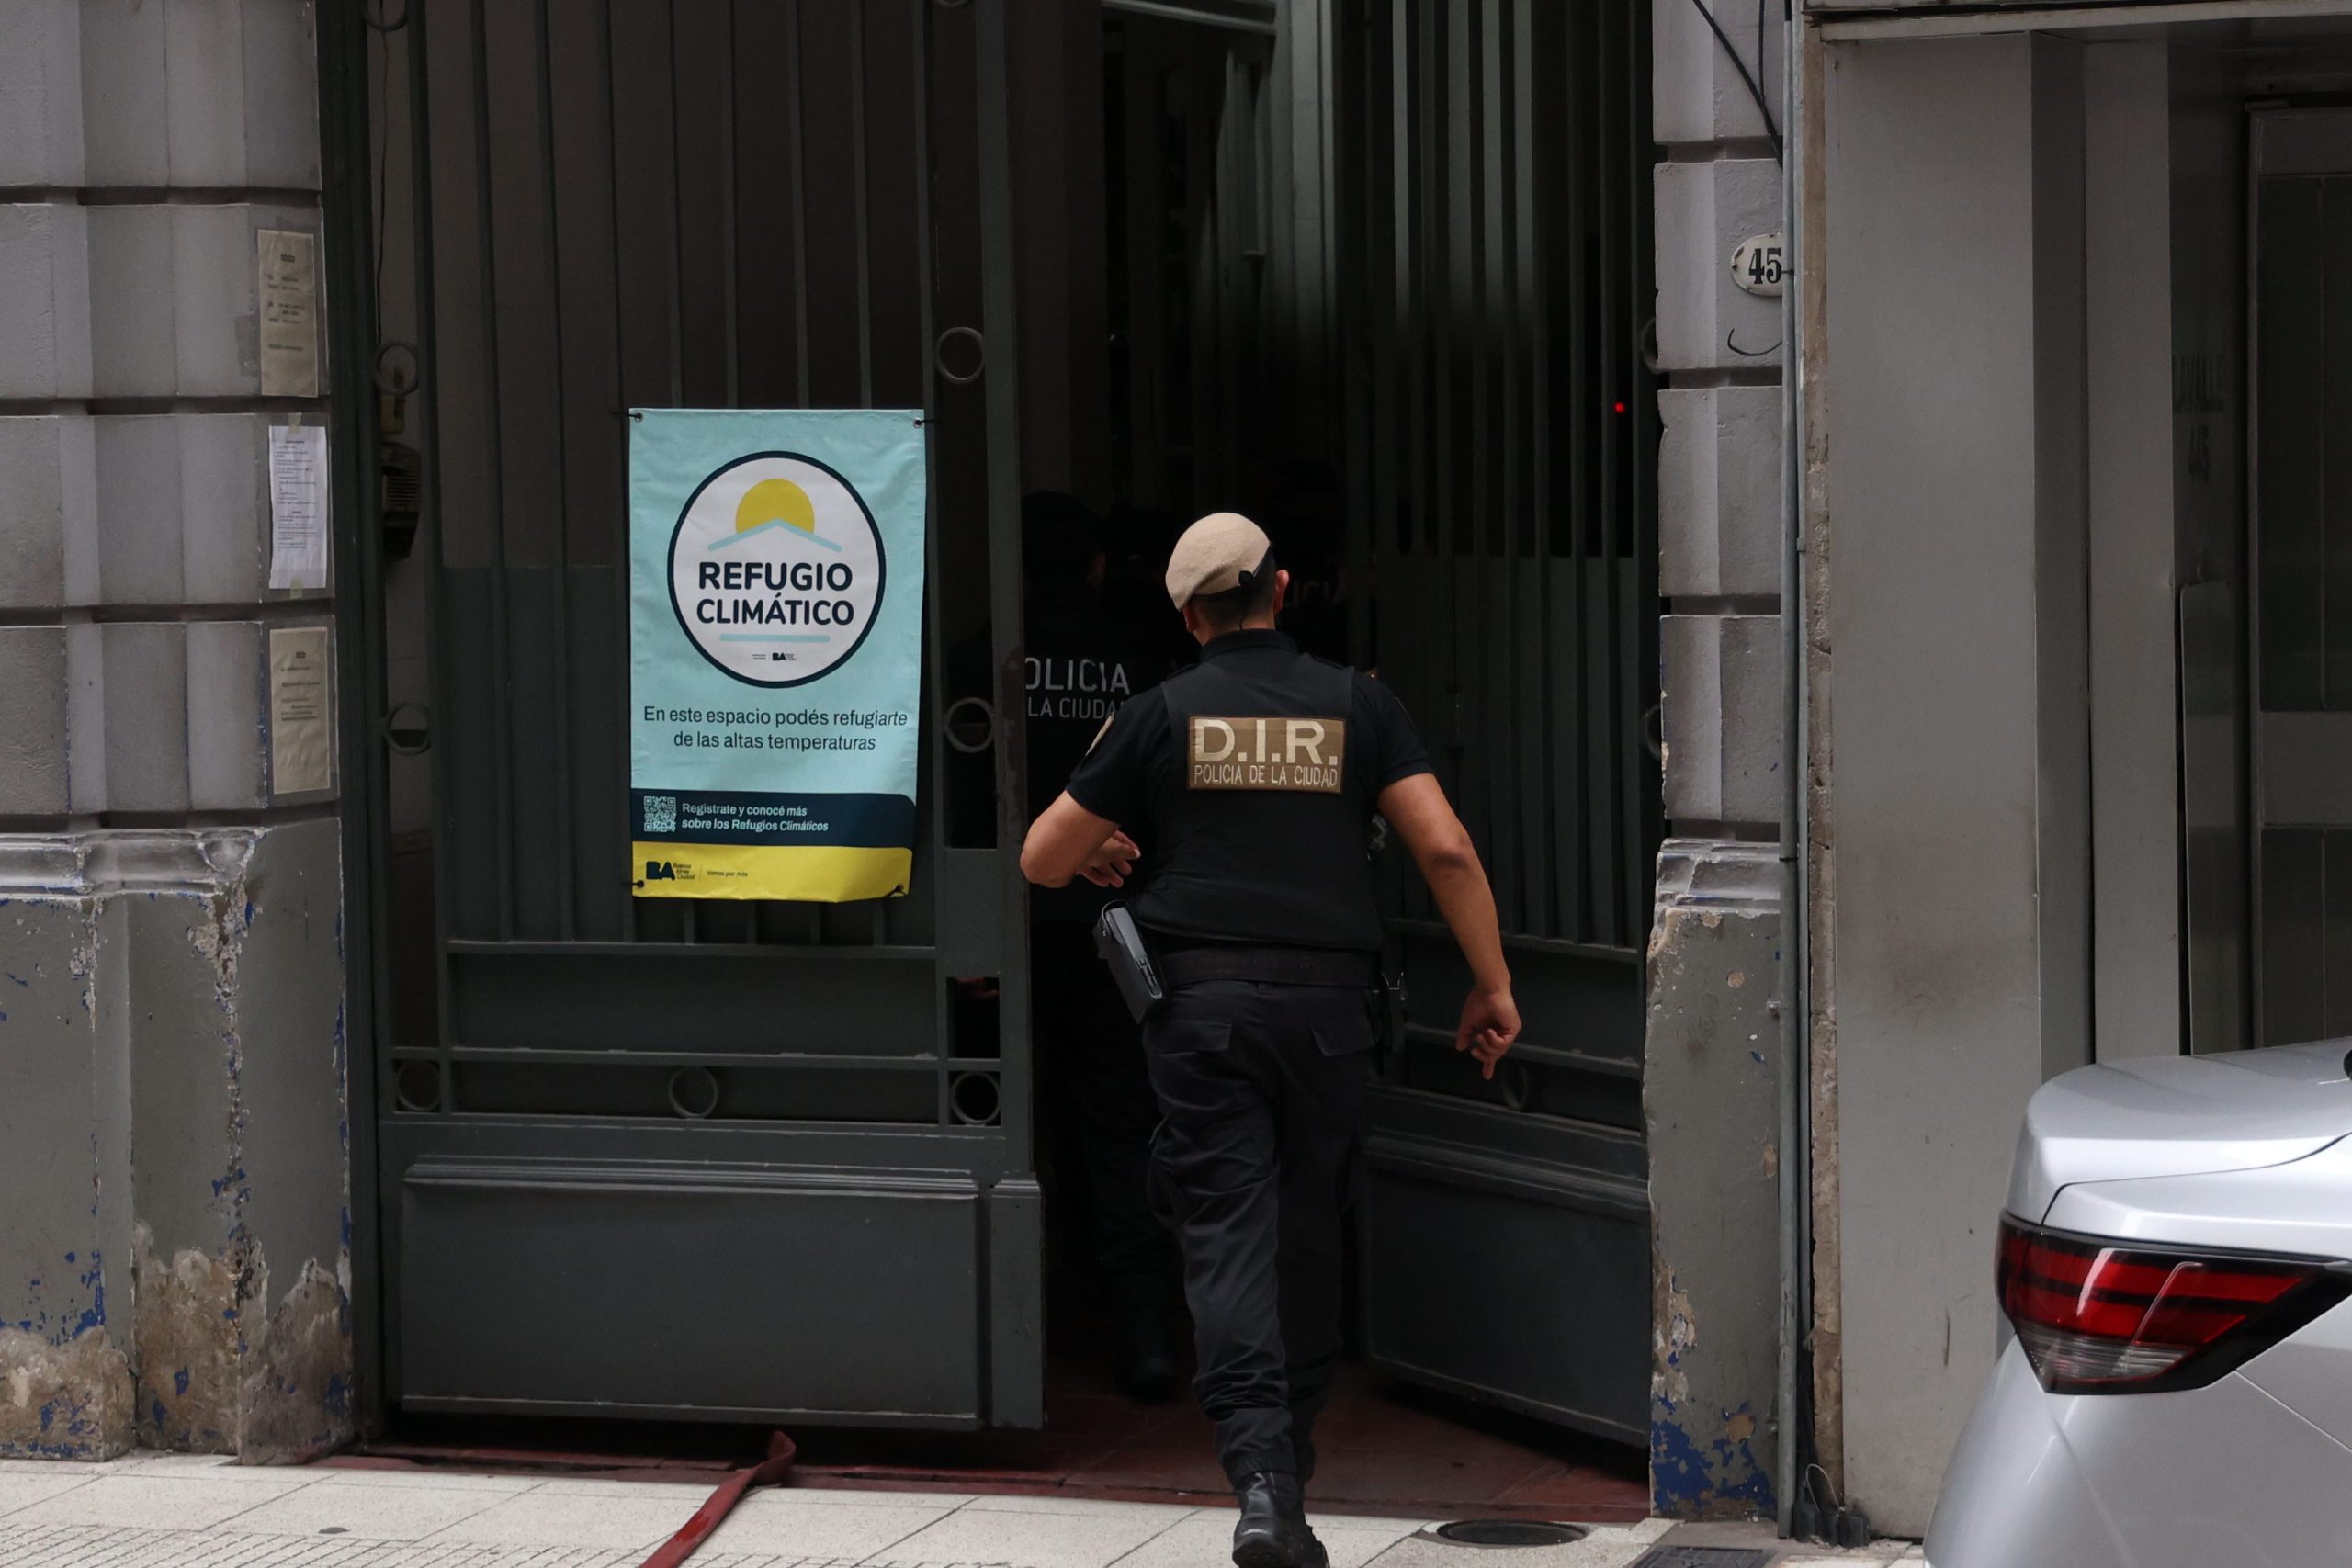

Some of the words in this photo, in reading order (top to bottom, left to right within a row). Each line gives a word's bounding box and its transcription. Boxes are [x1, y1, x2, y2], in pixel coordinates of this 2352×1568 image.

[698, 561, 854, 592] REFUGIO
[695, 592, 855, 626] CLIMÁTICO
[772, 651, 787, 661] BA
[1024, 656, 1131, 696] OLICIA
[643, 705, 665, 723] En
[669, 707, 703, 723] este
[706, 708, 772, 728] espacio
[775, 707, 830, 728] podés
[833, 709, 909, 729] refugiarte
[1027, 696, 1054, 718] LA
[1058, 697, 1125, 720] CIUDA
[673, 730, 694, 748] de
[697, 731, 720, 748] las
[724, 732, 764, 750] altas
[768, 733, 876, 752] temperaturas
[1194, 718, 1339, 766] D.I.R.
[1194, 763, 1243, 785] POLICIA
[1250, 764, 1266, 784] DE
[1272, 765, 1288, 785] LA
[1294, 765, 1339, 788] CIUDAD
[739, 807, 745, 817] y
[746, 804, 786, 817] conocé
[786, 805, 808, 817] más
[681, 818, 712, 829] sobre
[714, 818, 729, 829] los
[731, 818, 778, 833] Refugios
[780, 819, 829, 832] Climáticos
[646, 860, 675, 881] BA
